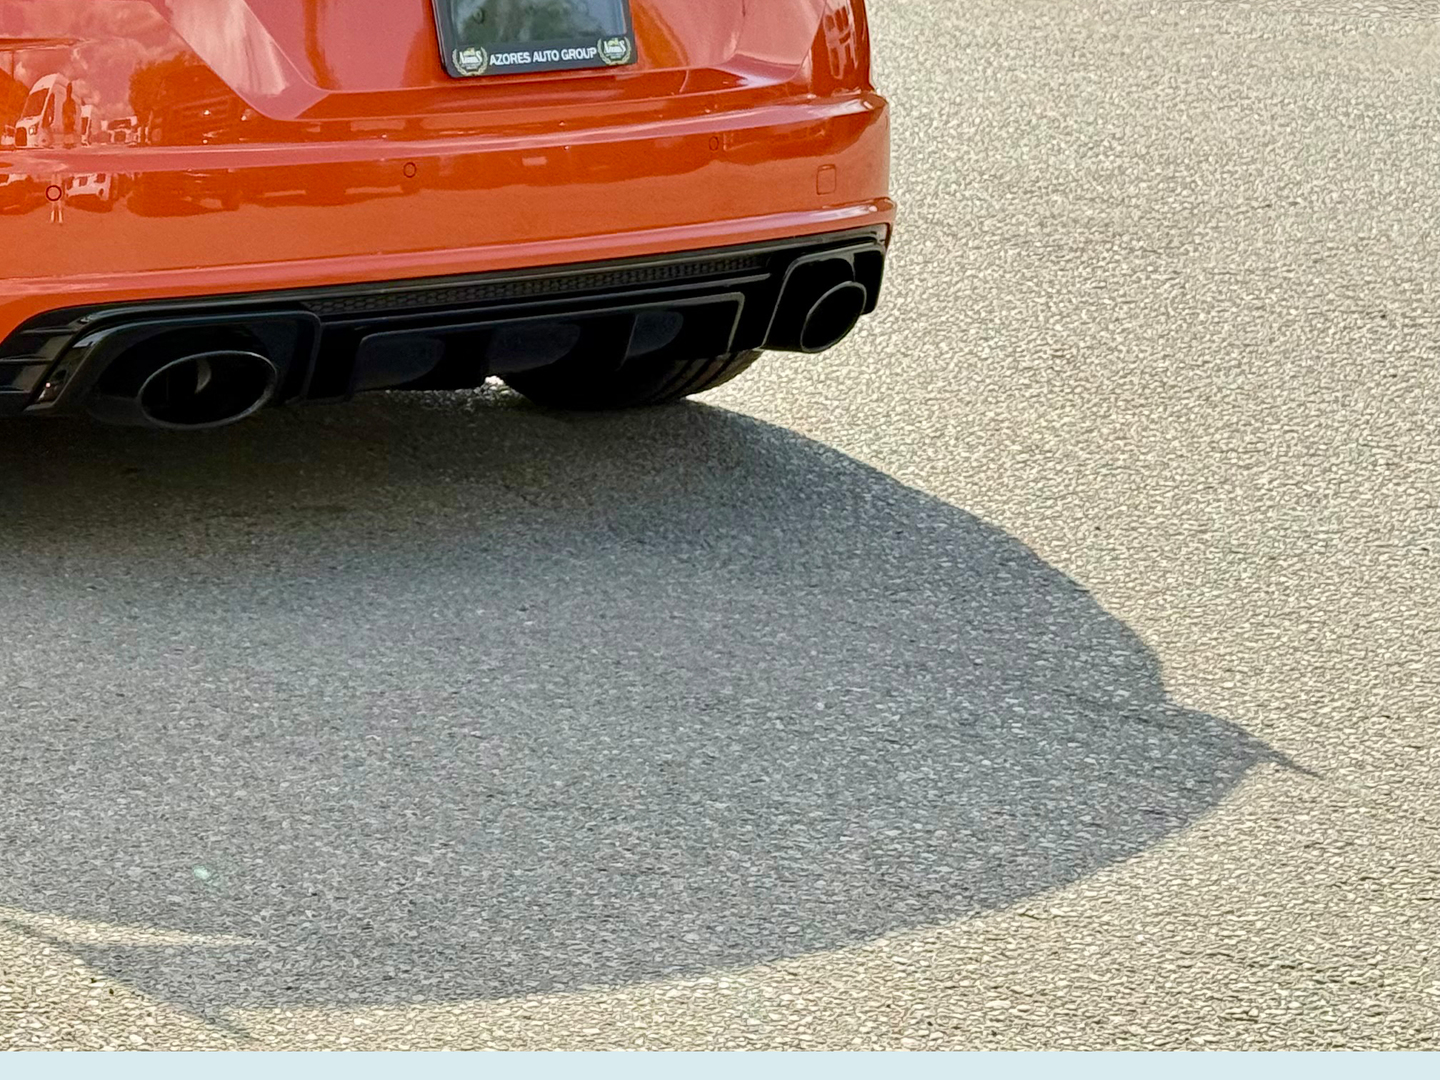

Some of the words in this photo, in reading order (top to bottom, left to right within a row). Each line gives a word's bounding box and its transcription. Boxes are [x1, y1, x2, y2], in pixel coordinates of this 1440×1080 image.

[489, 51, 532, 66] AZORES
[533, 49, 560, 63] AUTO
[561, 47, 597, 60] GROUP
